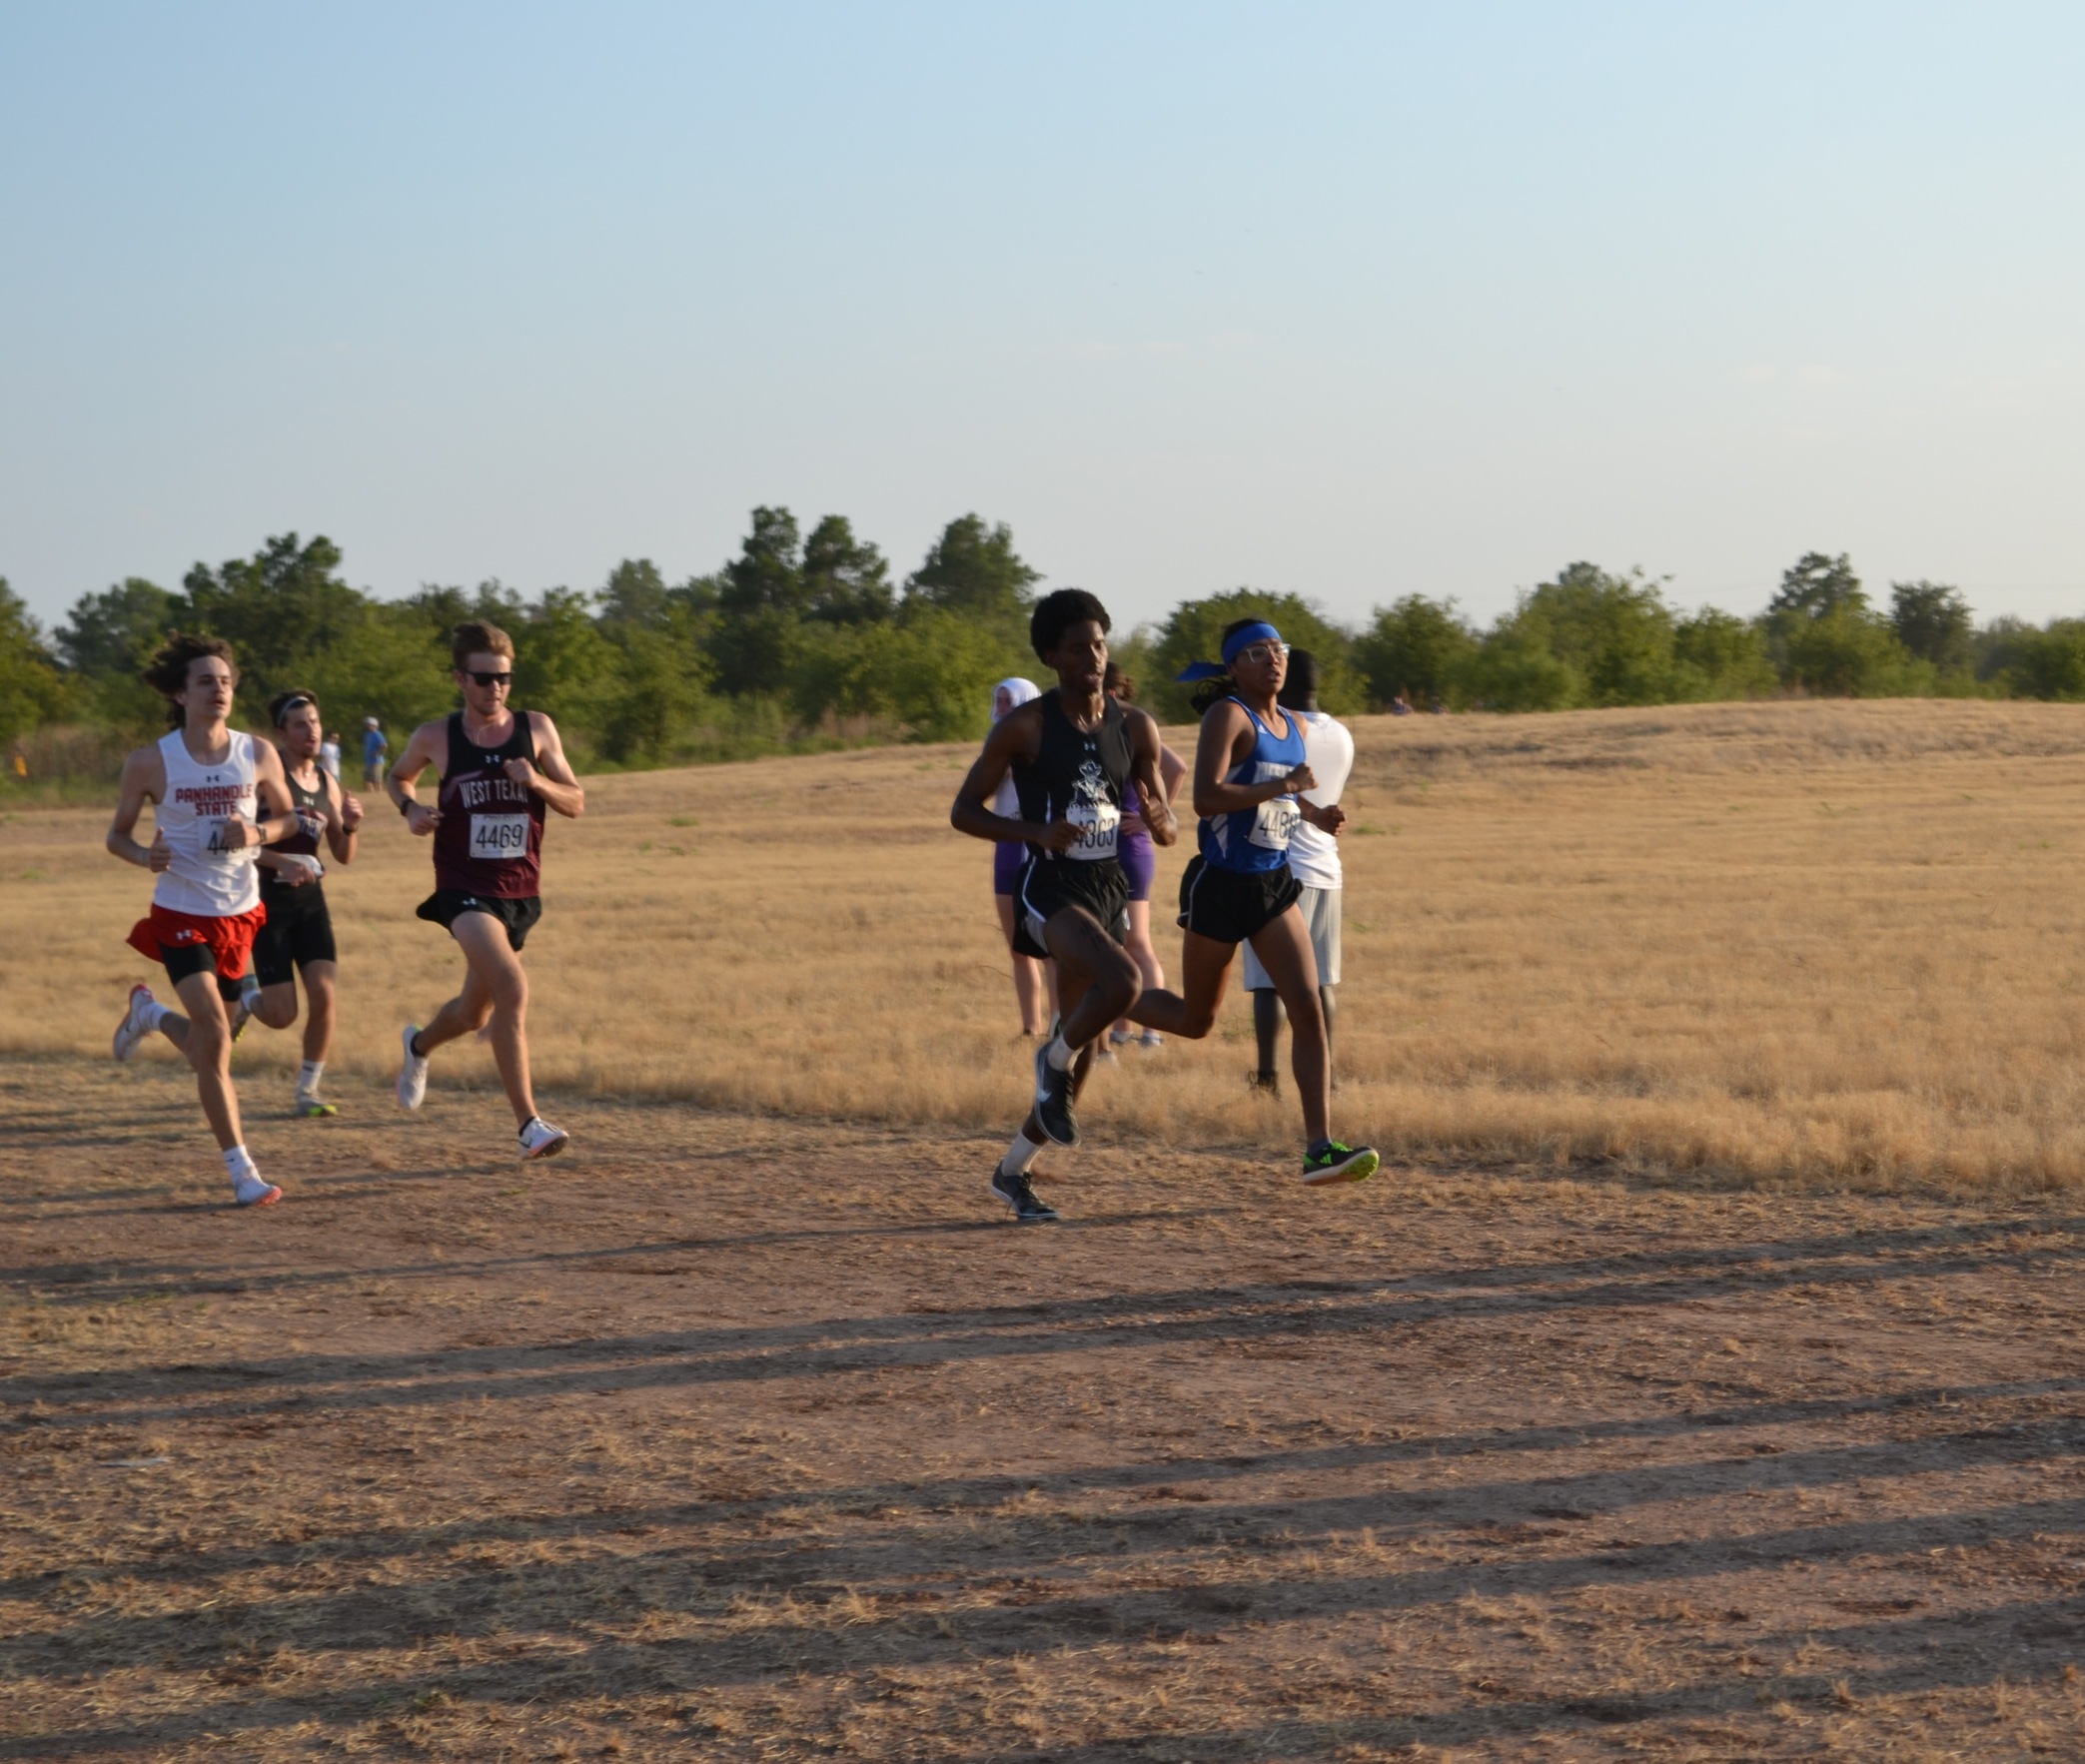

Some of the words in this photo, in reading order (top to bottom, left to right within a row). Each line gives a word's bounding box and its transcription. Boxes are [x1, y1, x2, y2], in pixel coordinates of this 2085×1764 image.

[175, 784, 252, 803] PANHANDLE
[460, 780, 491, 808] WEST
[195, 800, 236, 816] STATE
[476, 824, 523, 849] 4469
